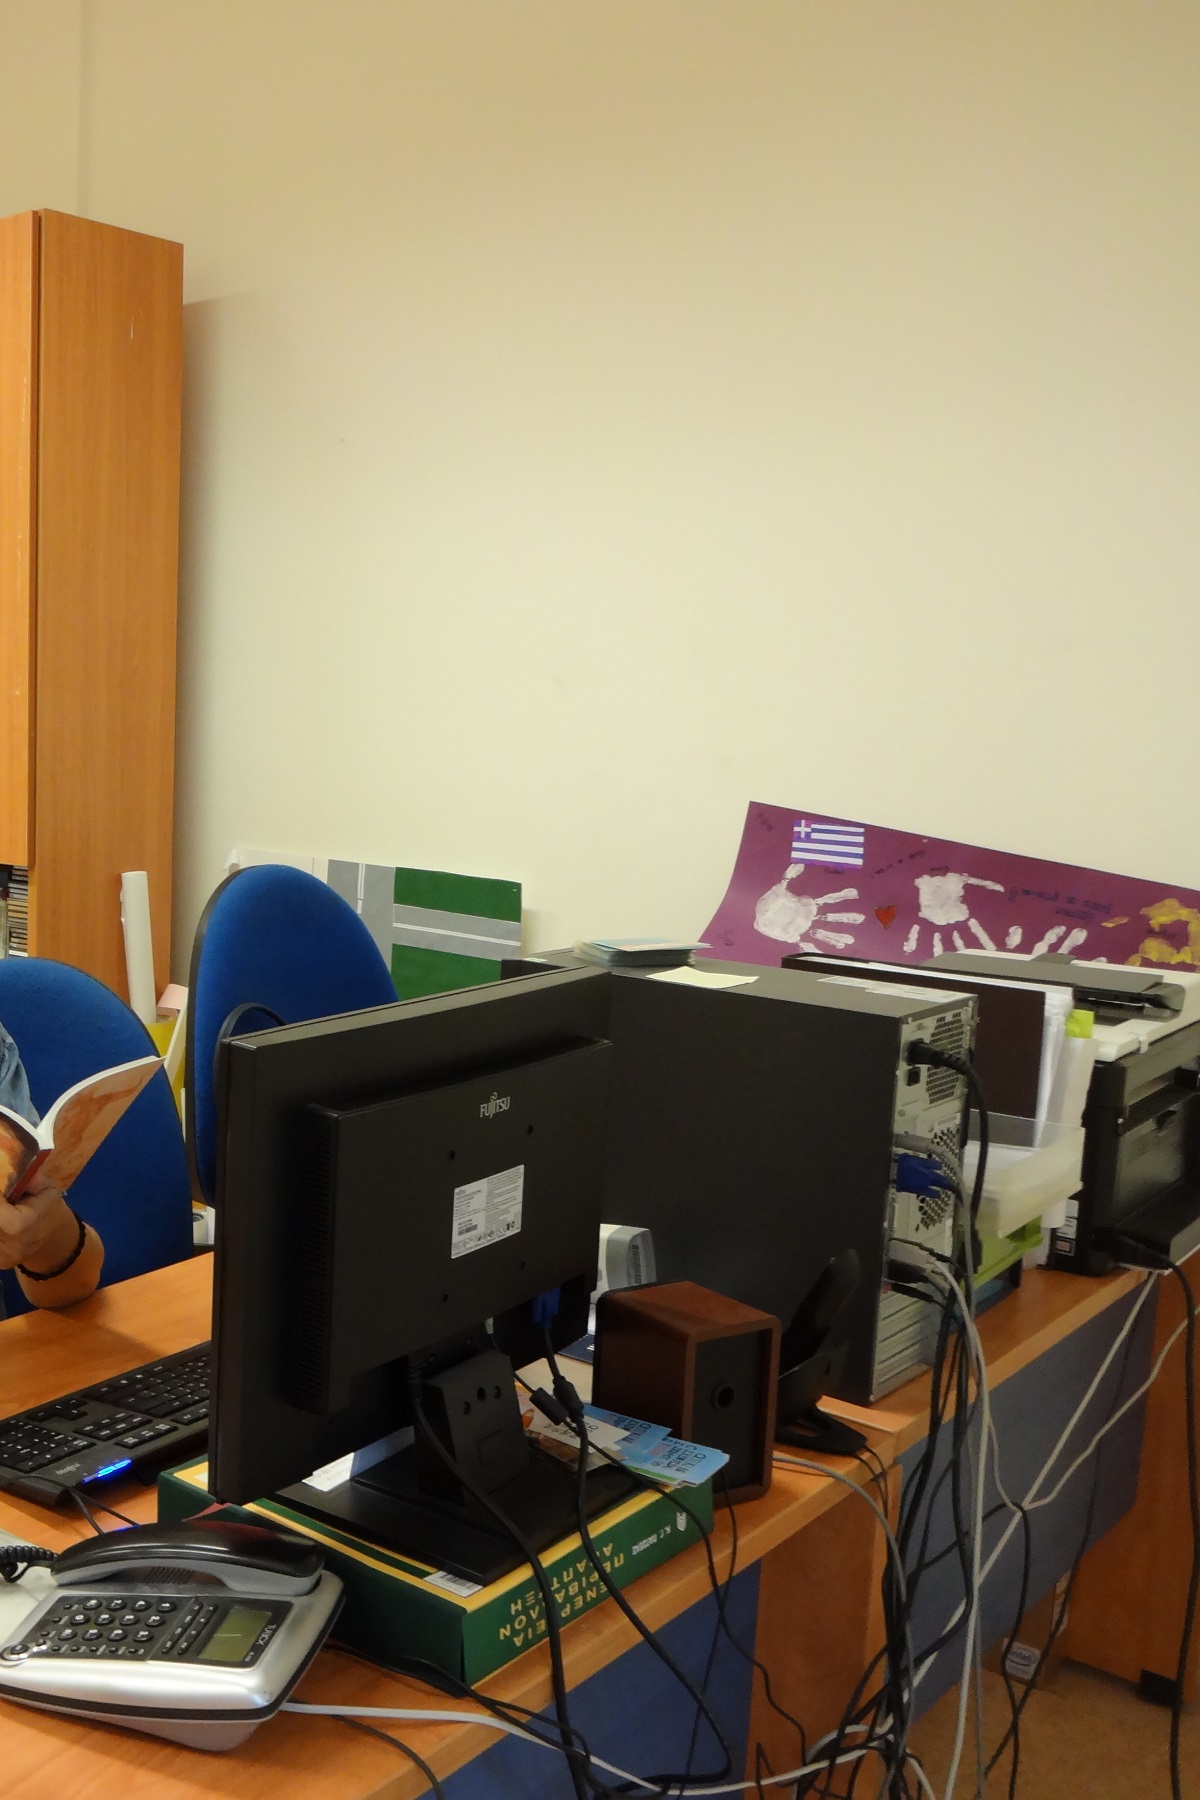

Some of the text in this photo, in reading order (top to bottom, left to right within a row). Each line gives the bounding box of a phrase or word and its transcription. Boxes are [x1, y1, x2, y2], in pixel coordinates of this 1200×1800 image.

[480, 1095, 511, 1119] FUJITSU
[499, 1553, 625, 1641] ΠΕΡΙΒΑΛΟΝ
[513, 1582, 608, 1648] ΕΝΕΡΕΙΑ
